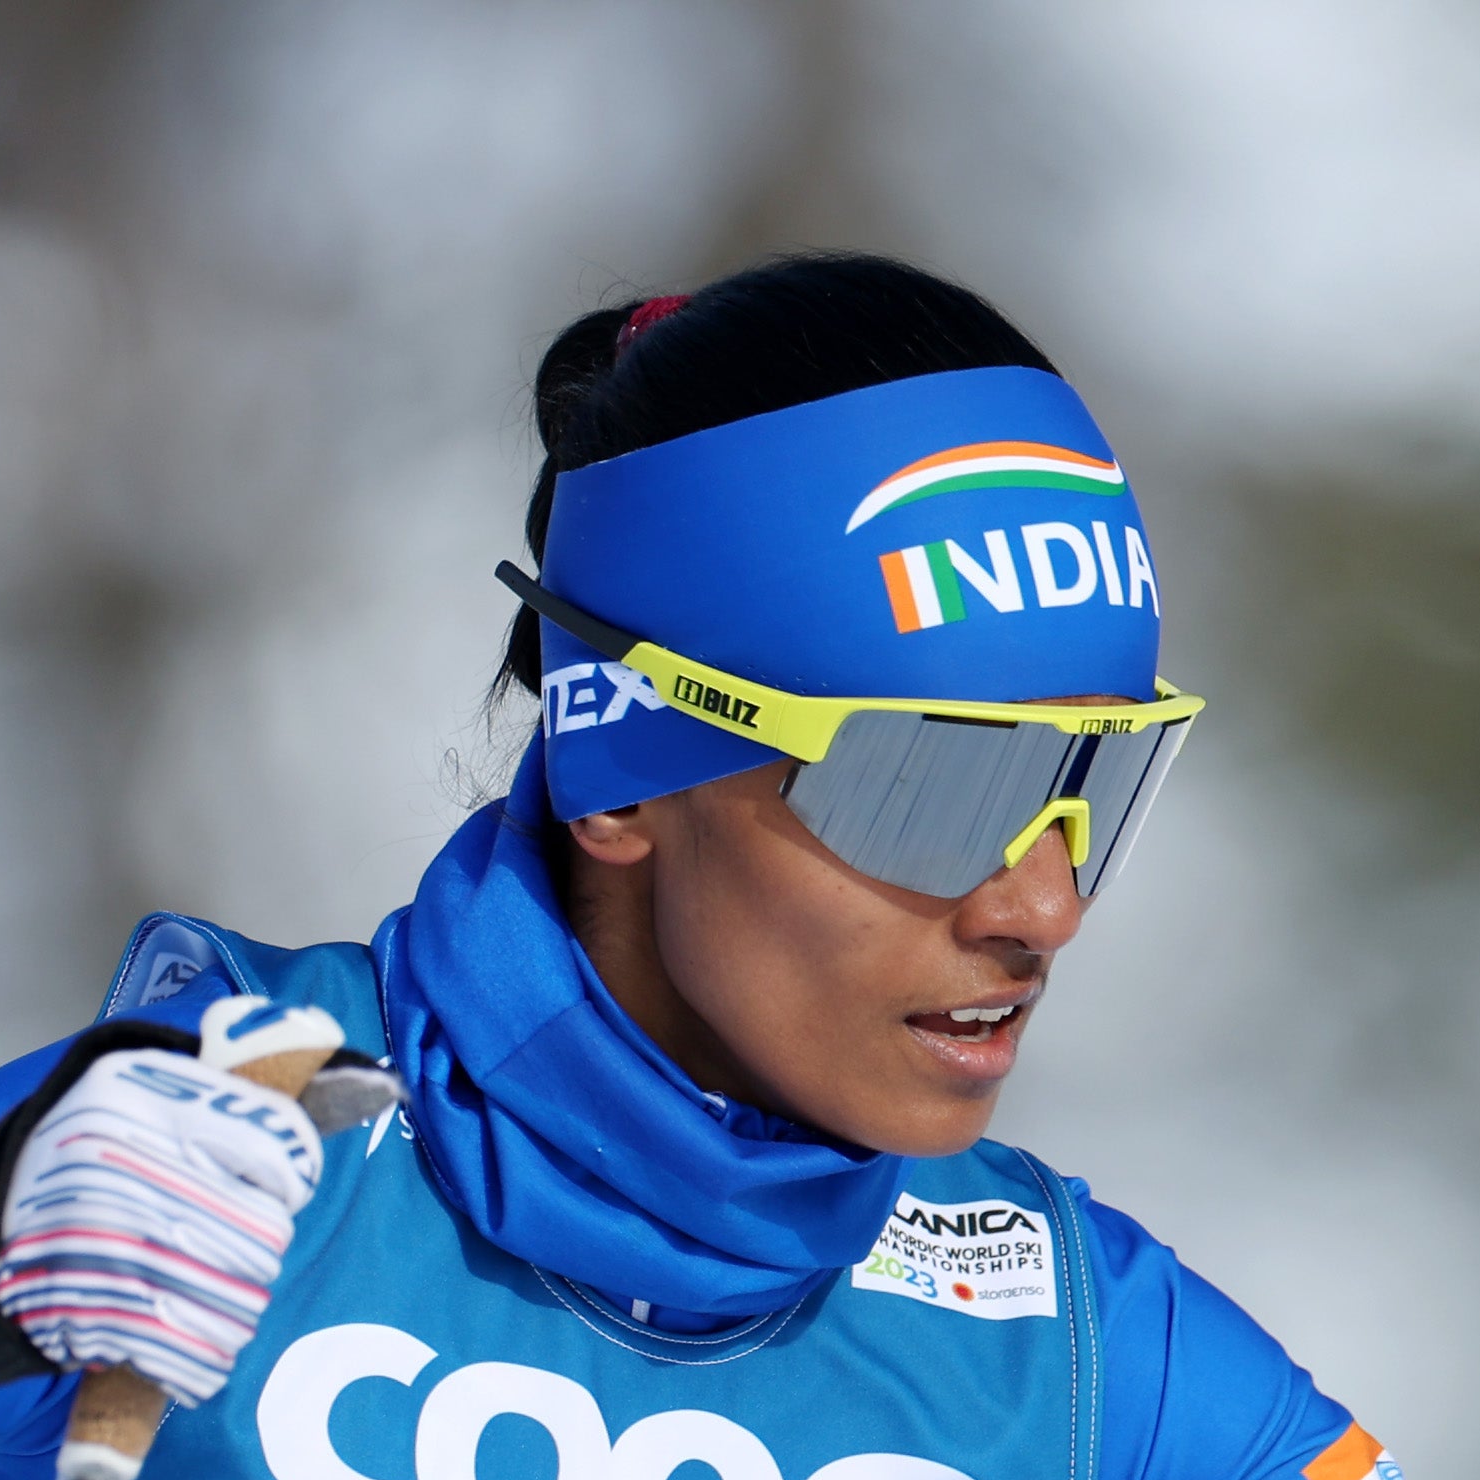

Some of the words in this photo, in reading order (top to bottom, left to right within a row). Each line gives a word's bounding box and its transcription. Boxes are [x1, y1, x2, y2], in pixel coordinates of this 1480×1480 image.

[879, 521, 1160, 633] INDIA
[702, 687, 762, 729] BLIZ
[1101, 718, 1134, 734] BLIZ
[889, 1224, 944, 1257] NORDIC
[944, 1243, 1011, 1261] WORLD
[1015, 1242, 1042, 1256] SKI
[893, 1208, 1040, 1238] LANICA
[880, 1236, 1044, 1275] HAMPIONSHIPS
[865, 1252, 938, 1299] 2023
